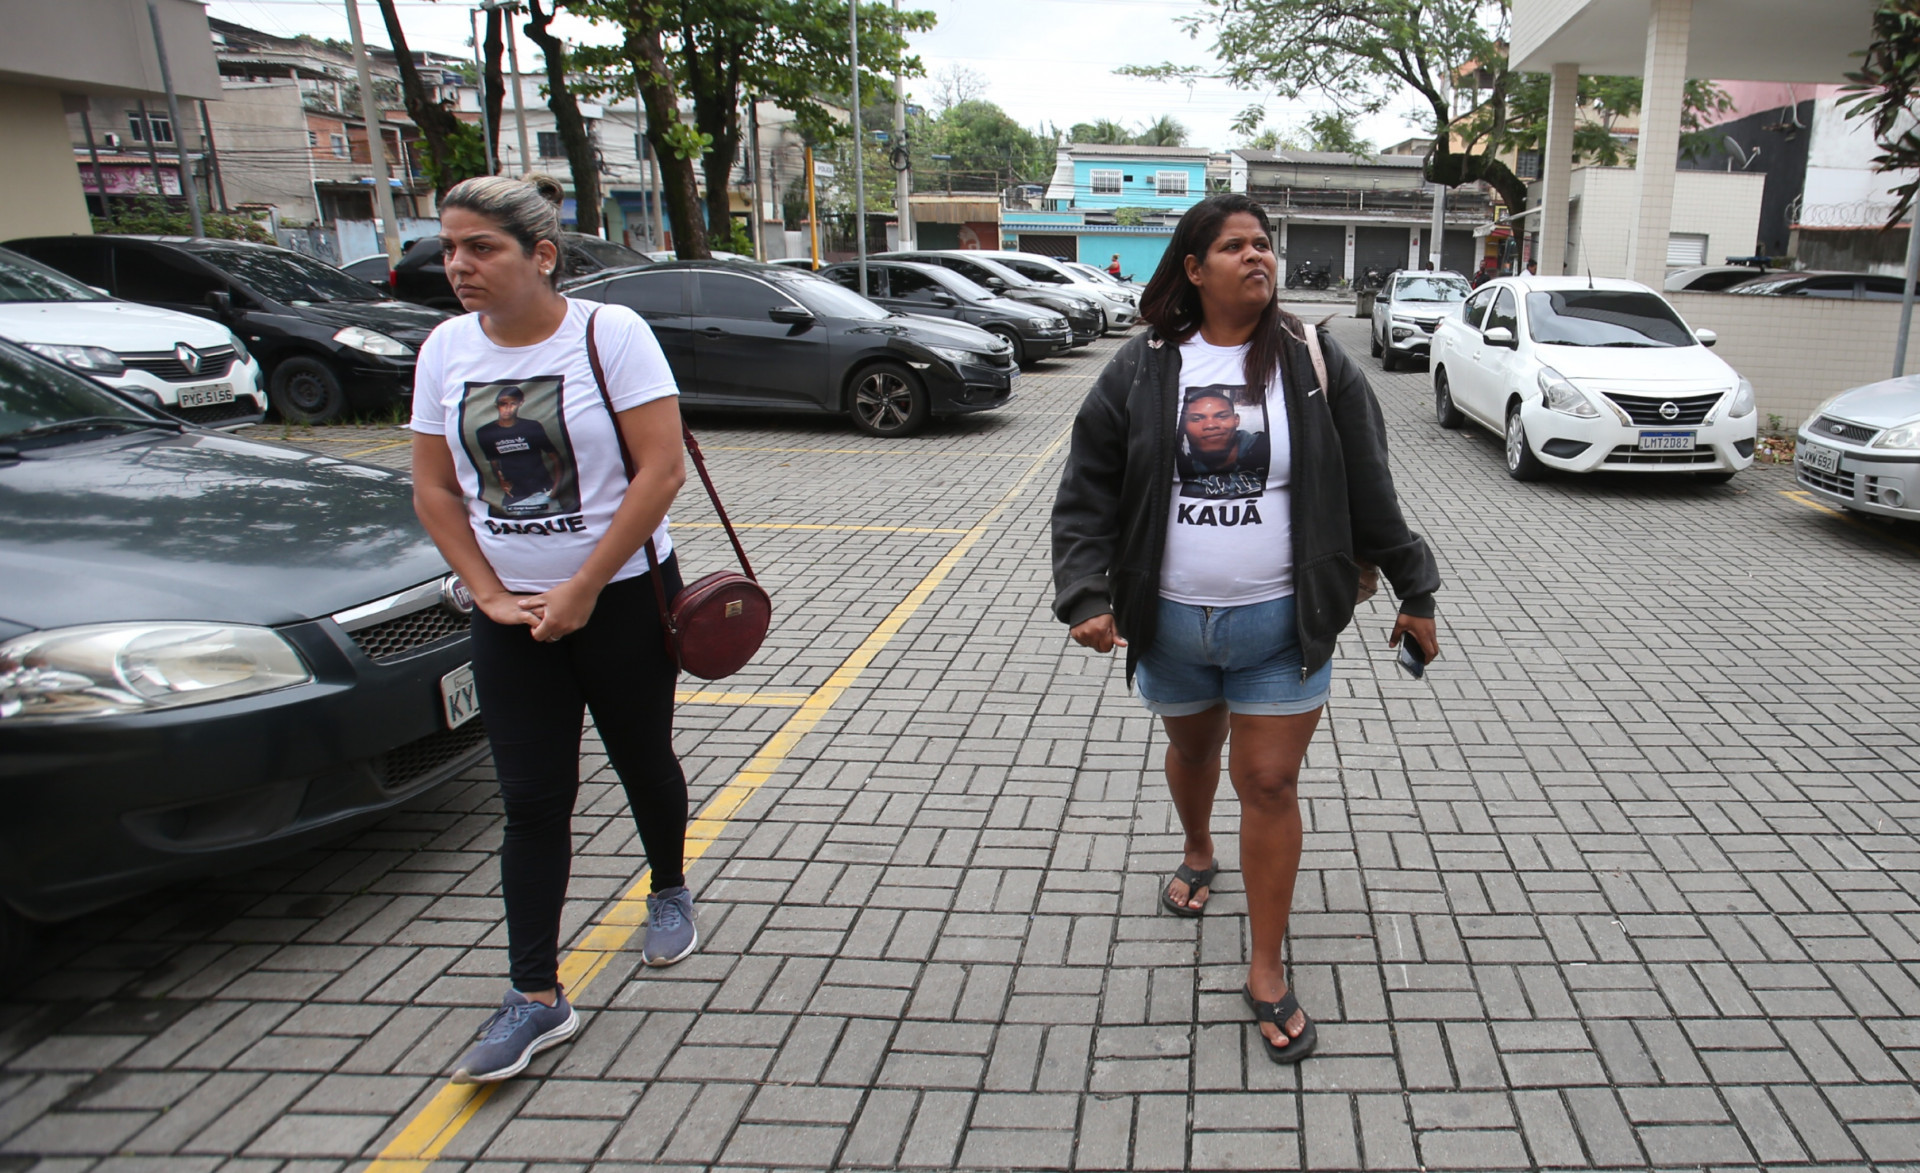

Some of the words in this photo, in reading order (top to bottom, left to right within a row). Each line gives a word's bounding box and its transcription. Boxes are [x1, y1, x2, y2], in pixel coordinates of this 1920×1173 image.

[1644, 437, 1689, 449] LMT2D82
[1817, 454, 1836, 471] 6921
[1177, 499, 1262, 527] KAUÃ
